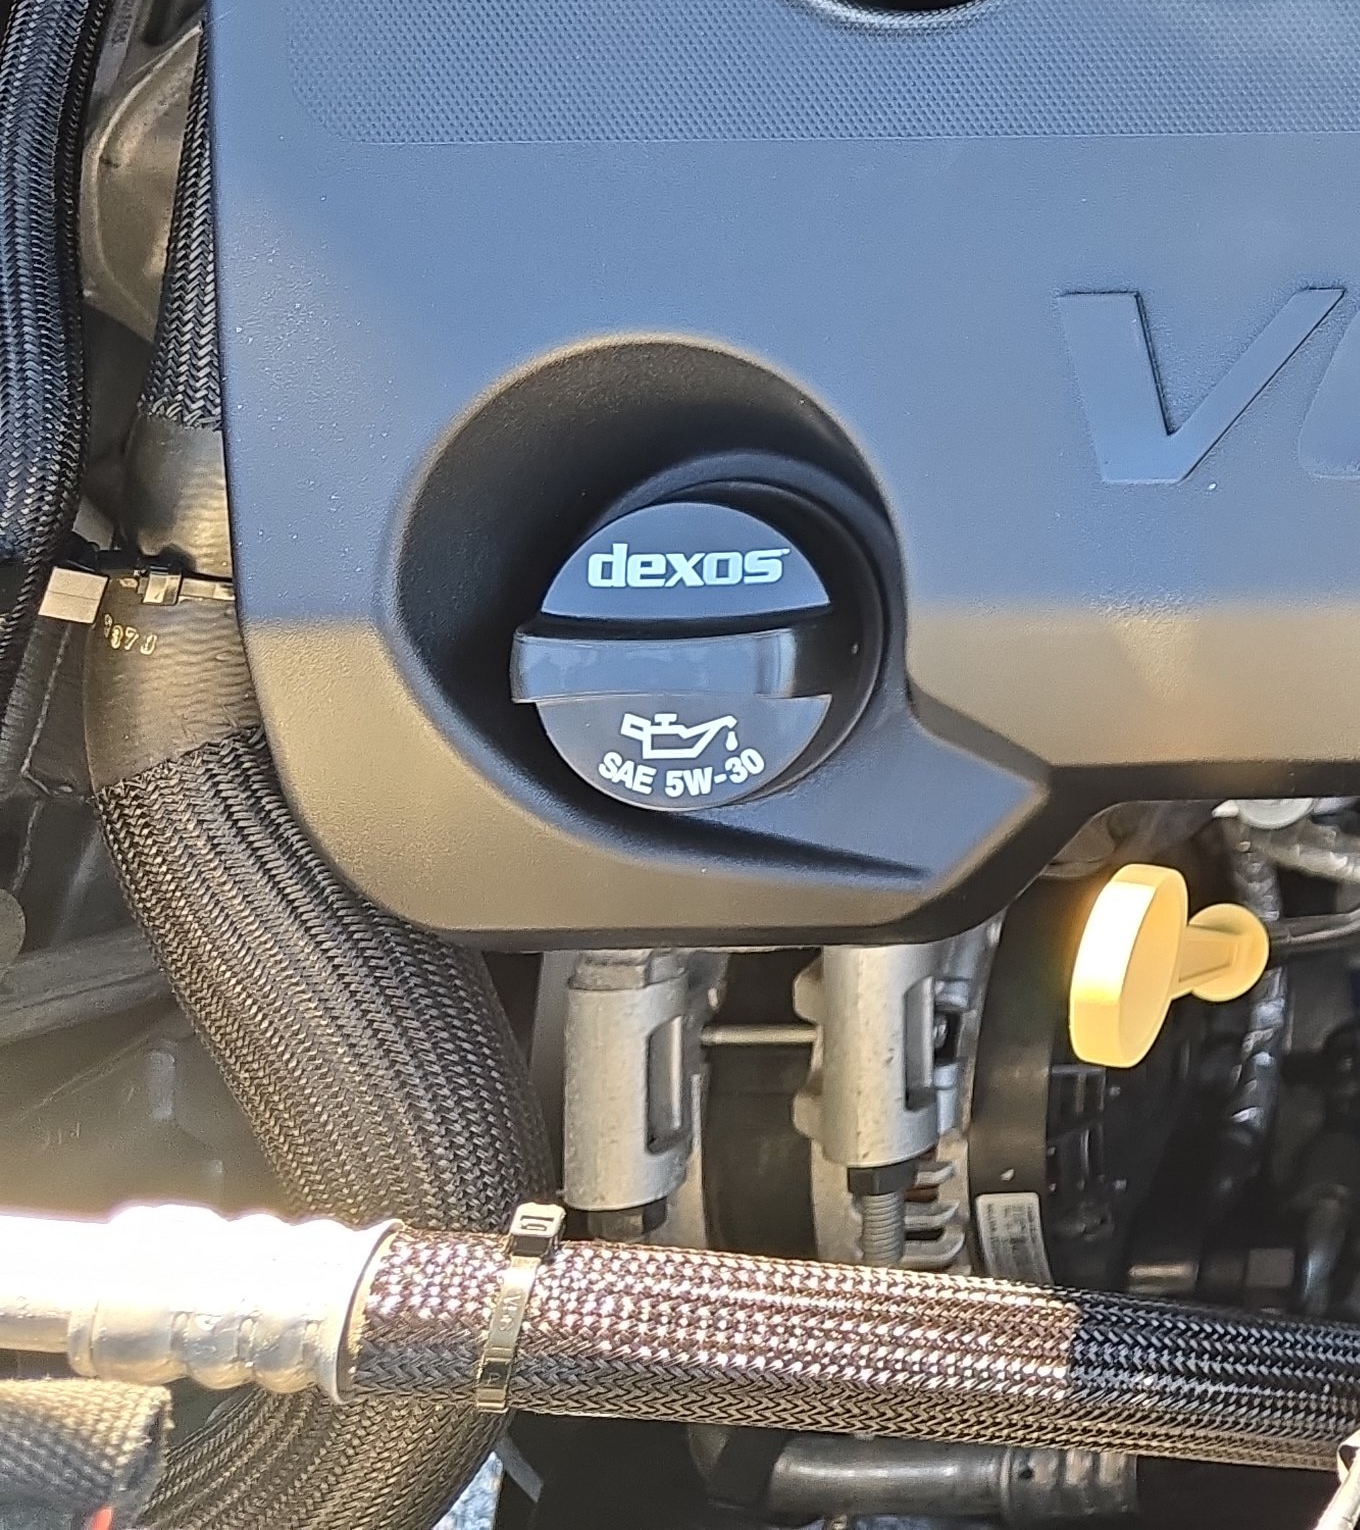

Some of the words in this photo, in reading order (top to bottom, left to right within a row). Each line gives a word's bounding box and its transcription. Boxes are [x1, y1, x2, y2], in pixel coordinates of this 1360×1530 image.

[588, 543, 790, 588] dexos
[598, 751, 657, 795] SAE
[664, 748, 765, 797] 5W-30
